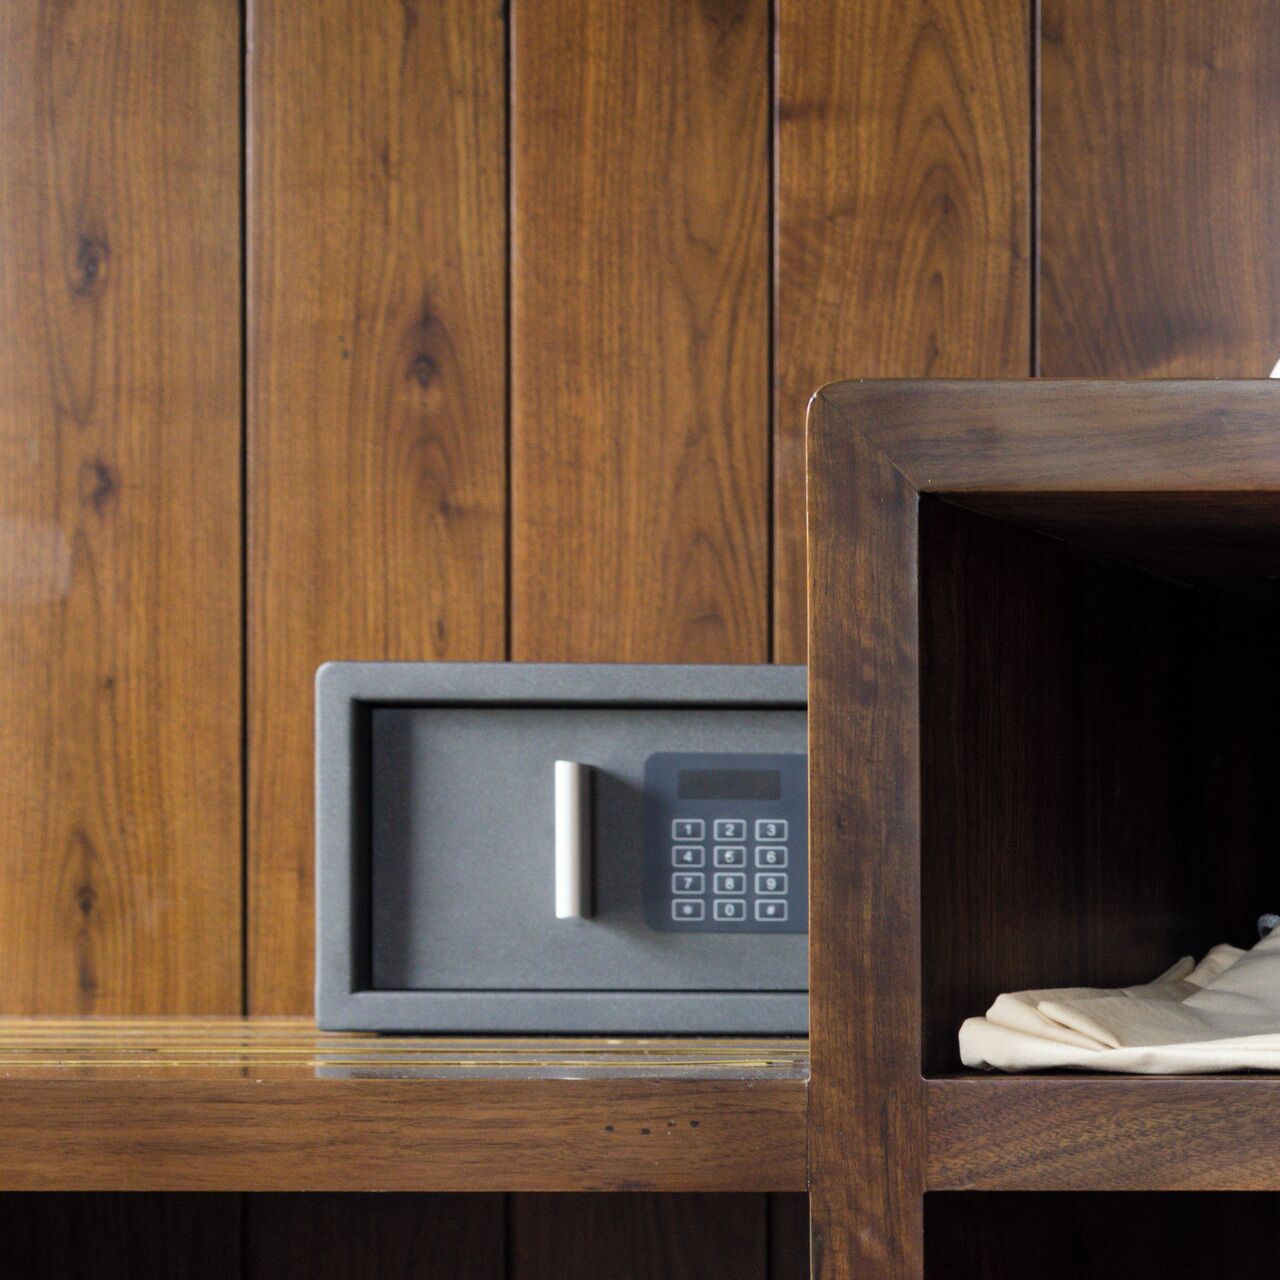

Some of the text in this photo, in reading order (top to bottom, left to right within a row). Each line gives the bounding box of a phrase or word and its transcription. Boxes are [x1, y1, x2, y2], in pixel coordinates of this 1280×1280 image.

[685, 824, 777, 836] 1 2 3
[683, 850, 777, 863] 4 5 6
[684, 877, 777, 891] 7 8 9
[724, 903, 735, 916] 0
